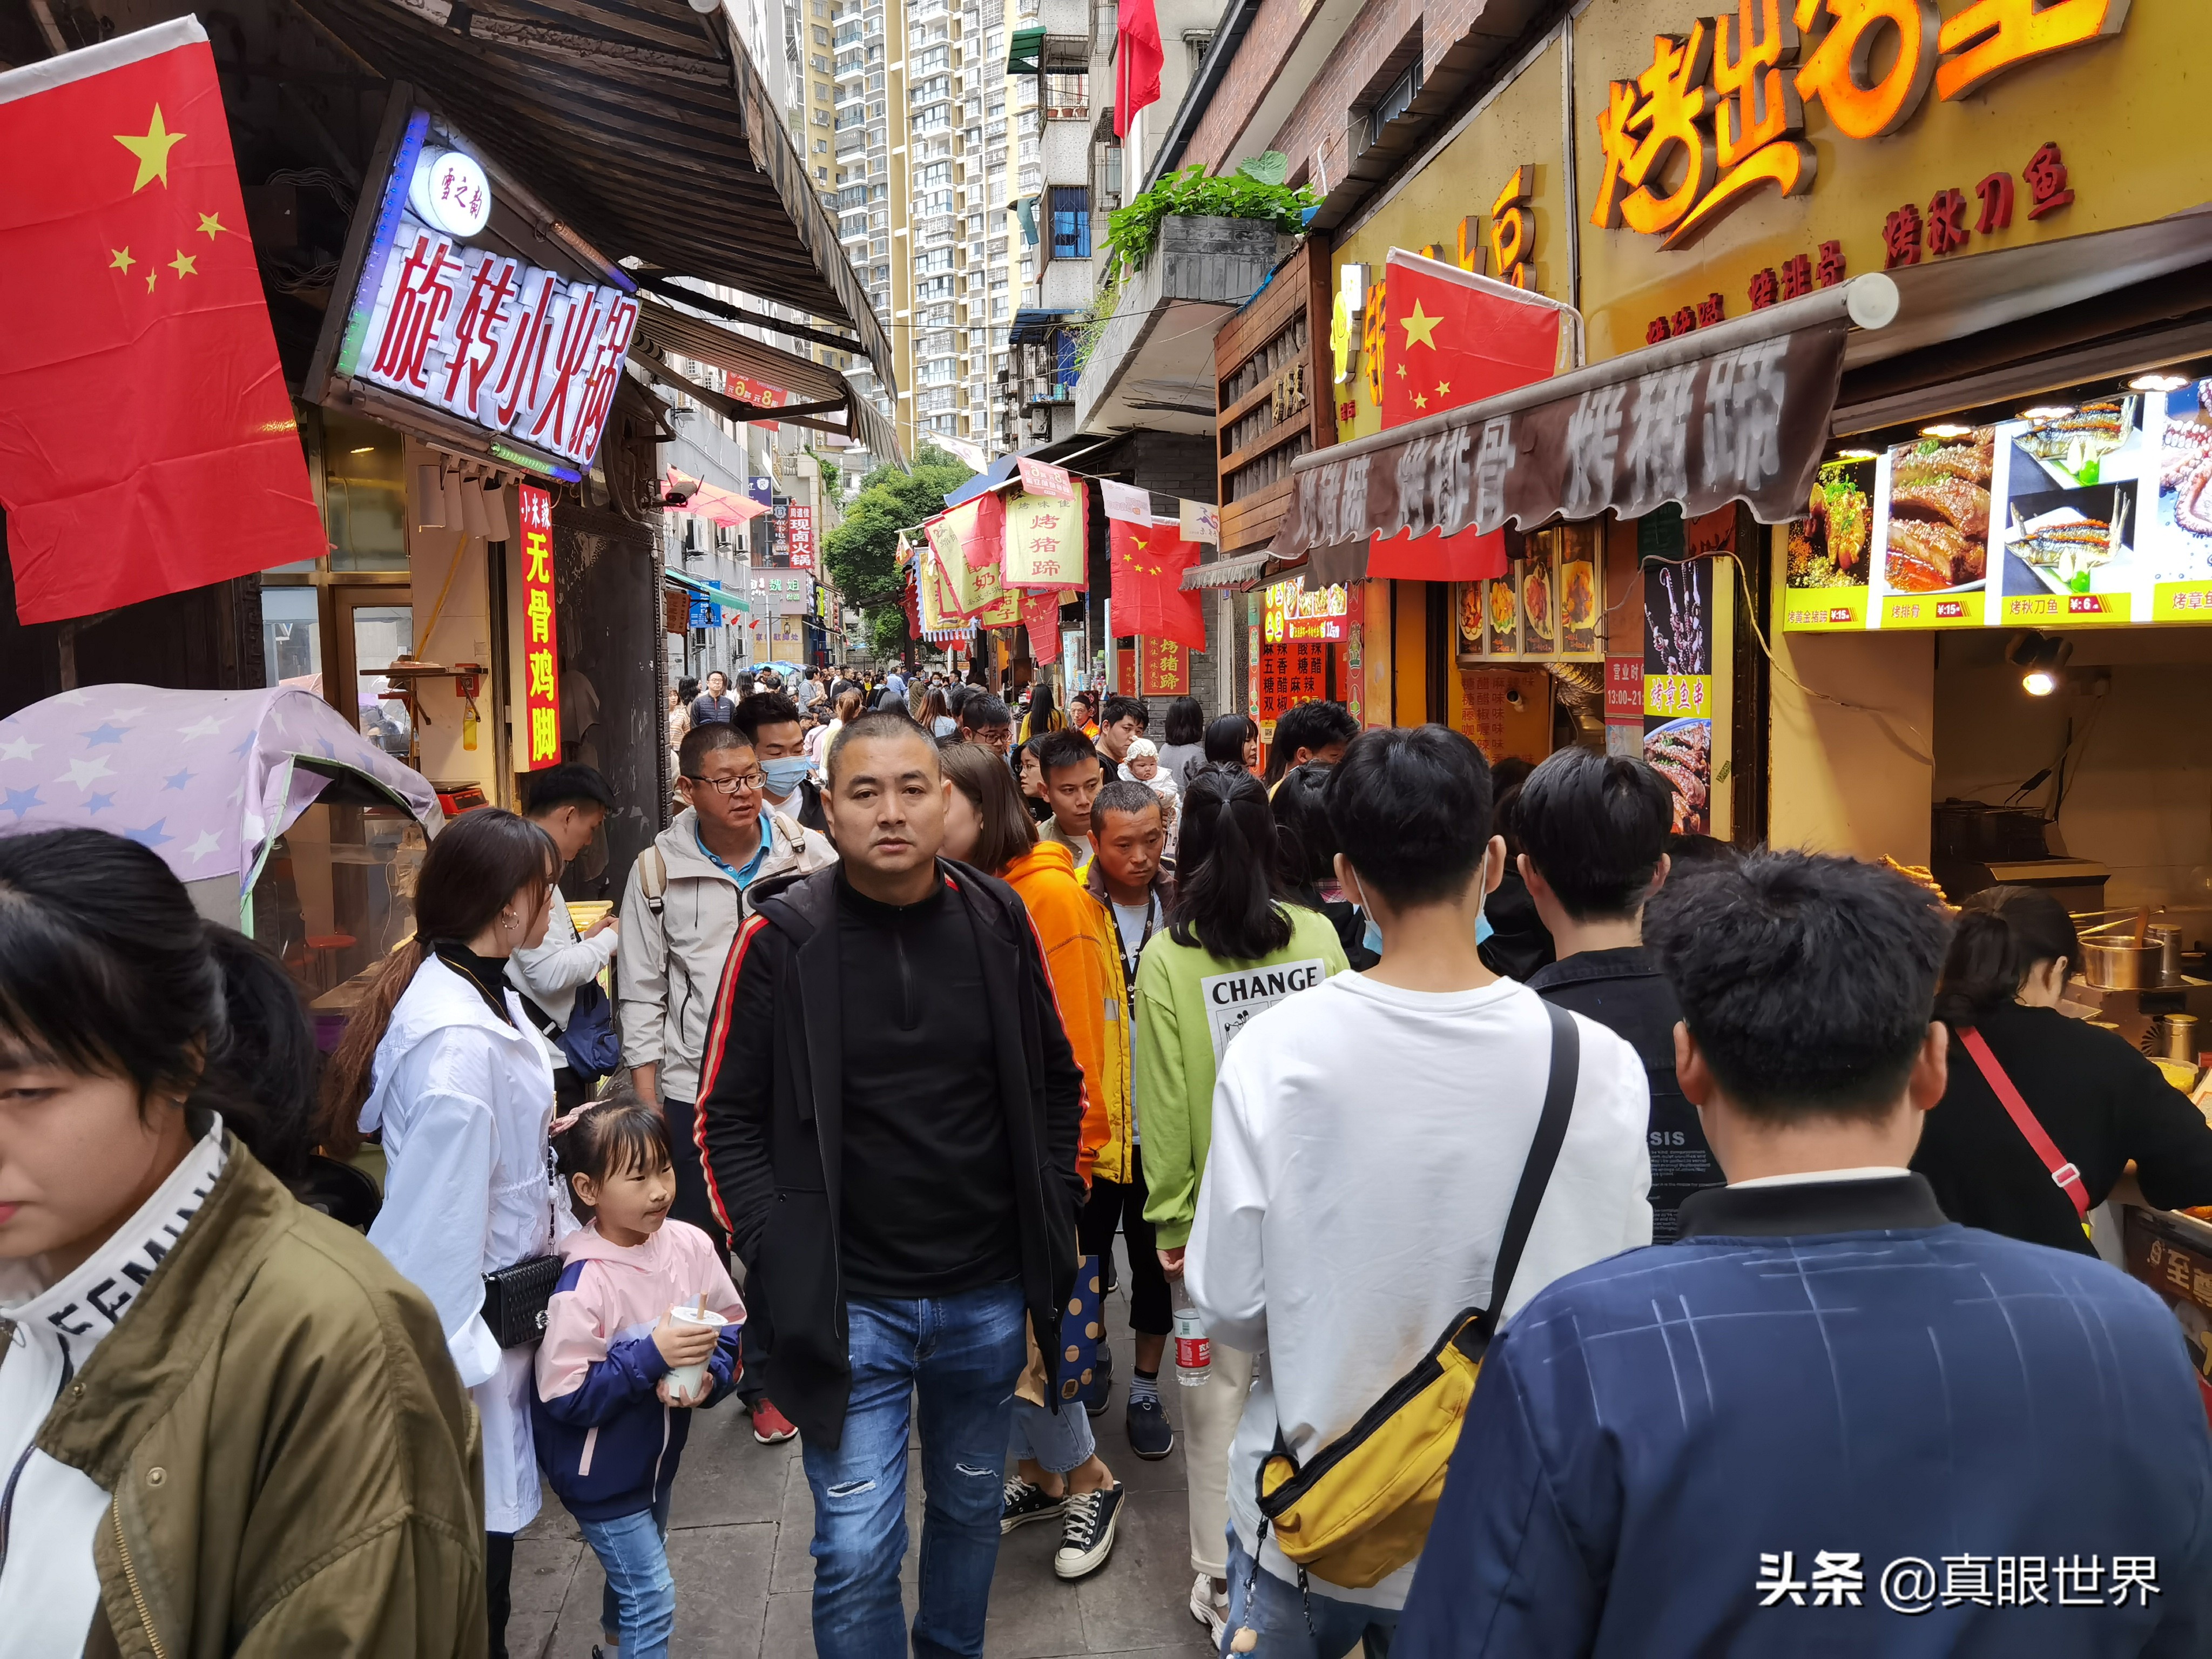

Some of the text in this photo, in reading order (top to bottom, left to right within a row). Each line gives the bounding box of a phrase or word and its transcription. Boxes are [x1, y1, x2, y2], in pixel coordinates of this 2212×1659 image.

[1882, 141, 2075, 269] 烤秋刀鱼
[372, 234, 637, 463] 旋转小火锅
[1397, 415, 1516, 534] 烤排骨
[521, 490, 551, 530] 小米辣
[789, 518, 811, 566] 现卤火锅
[1029, 515, 1061, 577] 烤猪蹄
[769, 578, 799, 591] 魏姐
[1891, 604, 1920, 619] 烤排骨
[2009, 597, 2059, 616] 烤秋刀鱼
[526, 532, 556, 762] 无骨鸡脚
[1263, 643, 1322, 656] 麻辣 酸辣
[1159, 639, 1179, 690] 烤猪蹄
[1263, 657, 1322, 675] 五香 糖醋
[1263, 676, 1315, 694] 糖醋麻辣
[1462, 692, 1505, 706] 糖醋味
[1650, 677, 1704, 716] 烤章鱼串
[1263, 695, 1288, 712] 双椒
[1461, 723, 1505, 737] 咖喱味
[1212, 966, 1319, 1005] CHANGE
[1649, 1131, 1685, 1145] SIS
